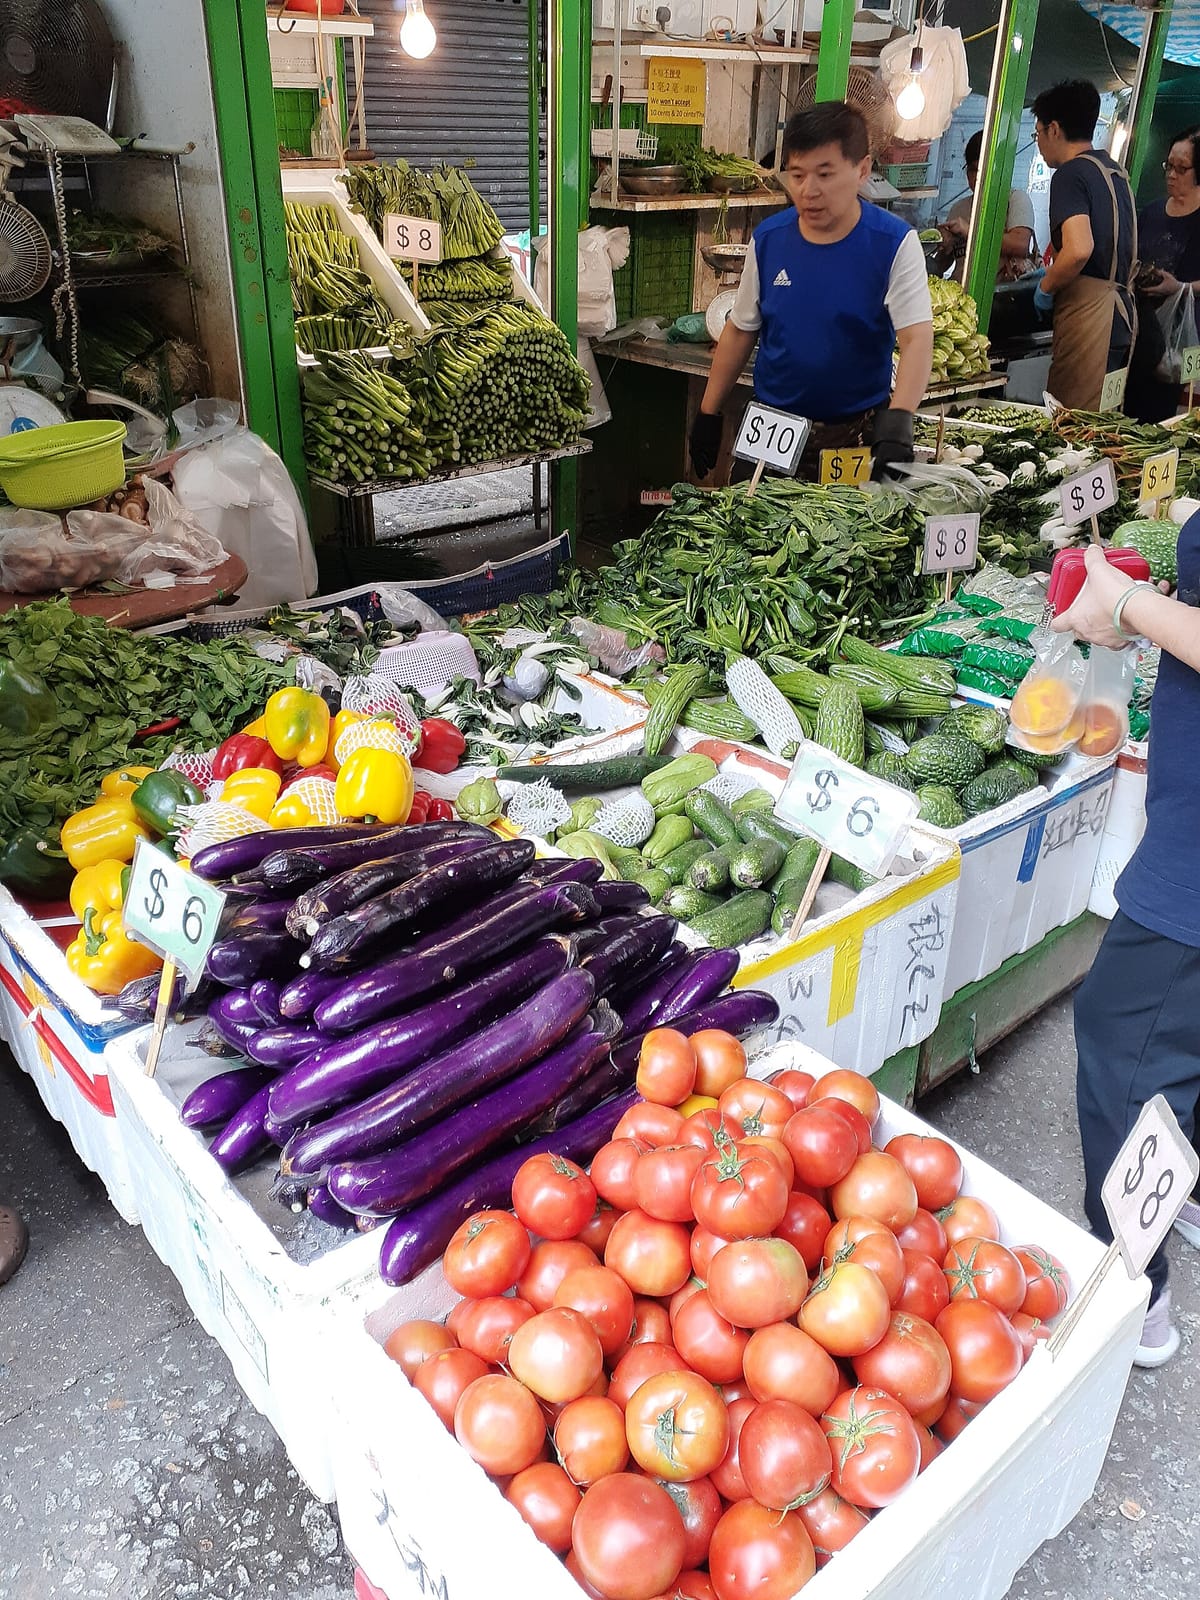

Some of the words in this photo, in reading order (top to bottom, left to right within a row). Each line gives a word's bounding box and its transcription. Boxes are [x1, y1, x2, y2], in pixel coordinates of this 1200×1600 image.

[396, 224, 410, 251] $
[418, 228, 432, 251] 8
[746, 415, 795, 455] $10
[935, 527, 948, 561] $
[954, 528, 967, 556] 8
[805, 769, 839, 815] $
[846, 796, 880, 838] 6
[143, 867, 169, 924] $
[182, 895, 207, 945] 6
[1120, 1133, 1159, 1200] $
[1139, 1168, 1175, 1231] 8
